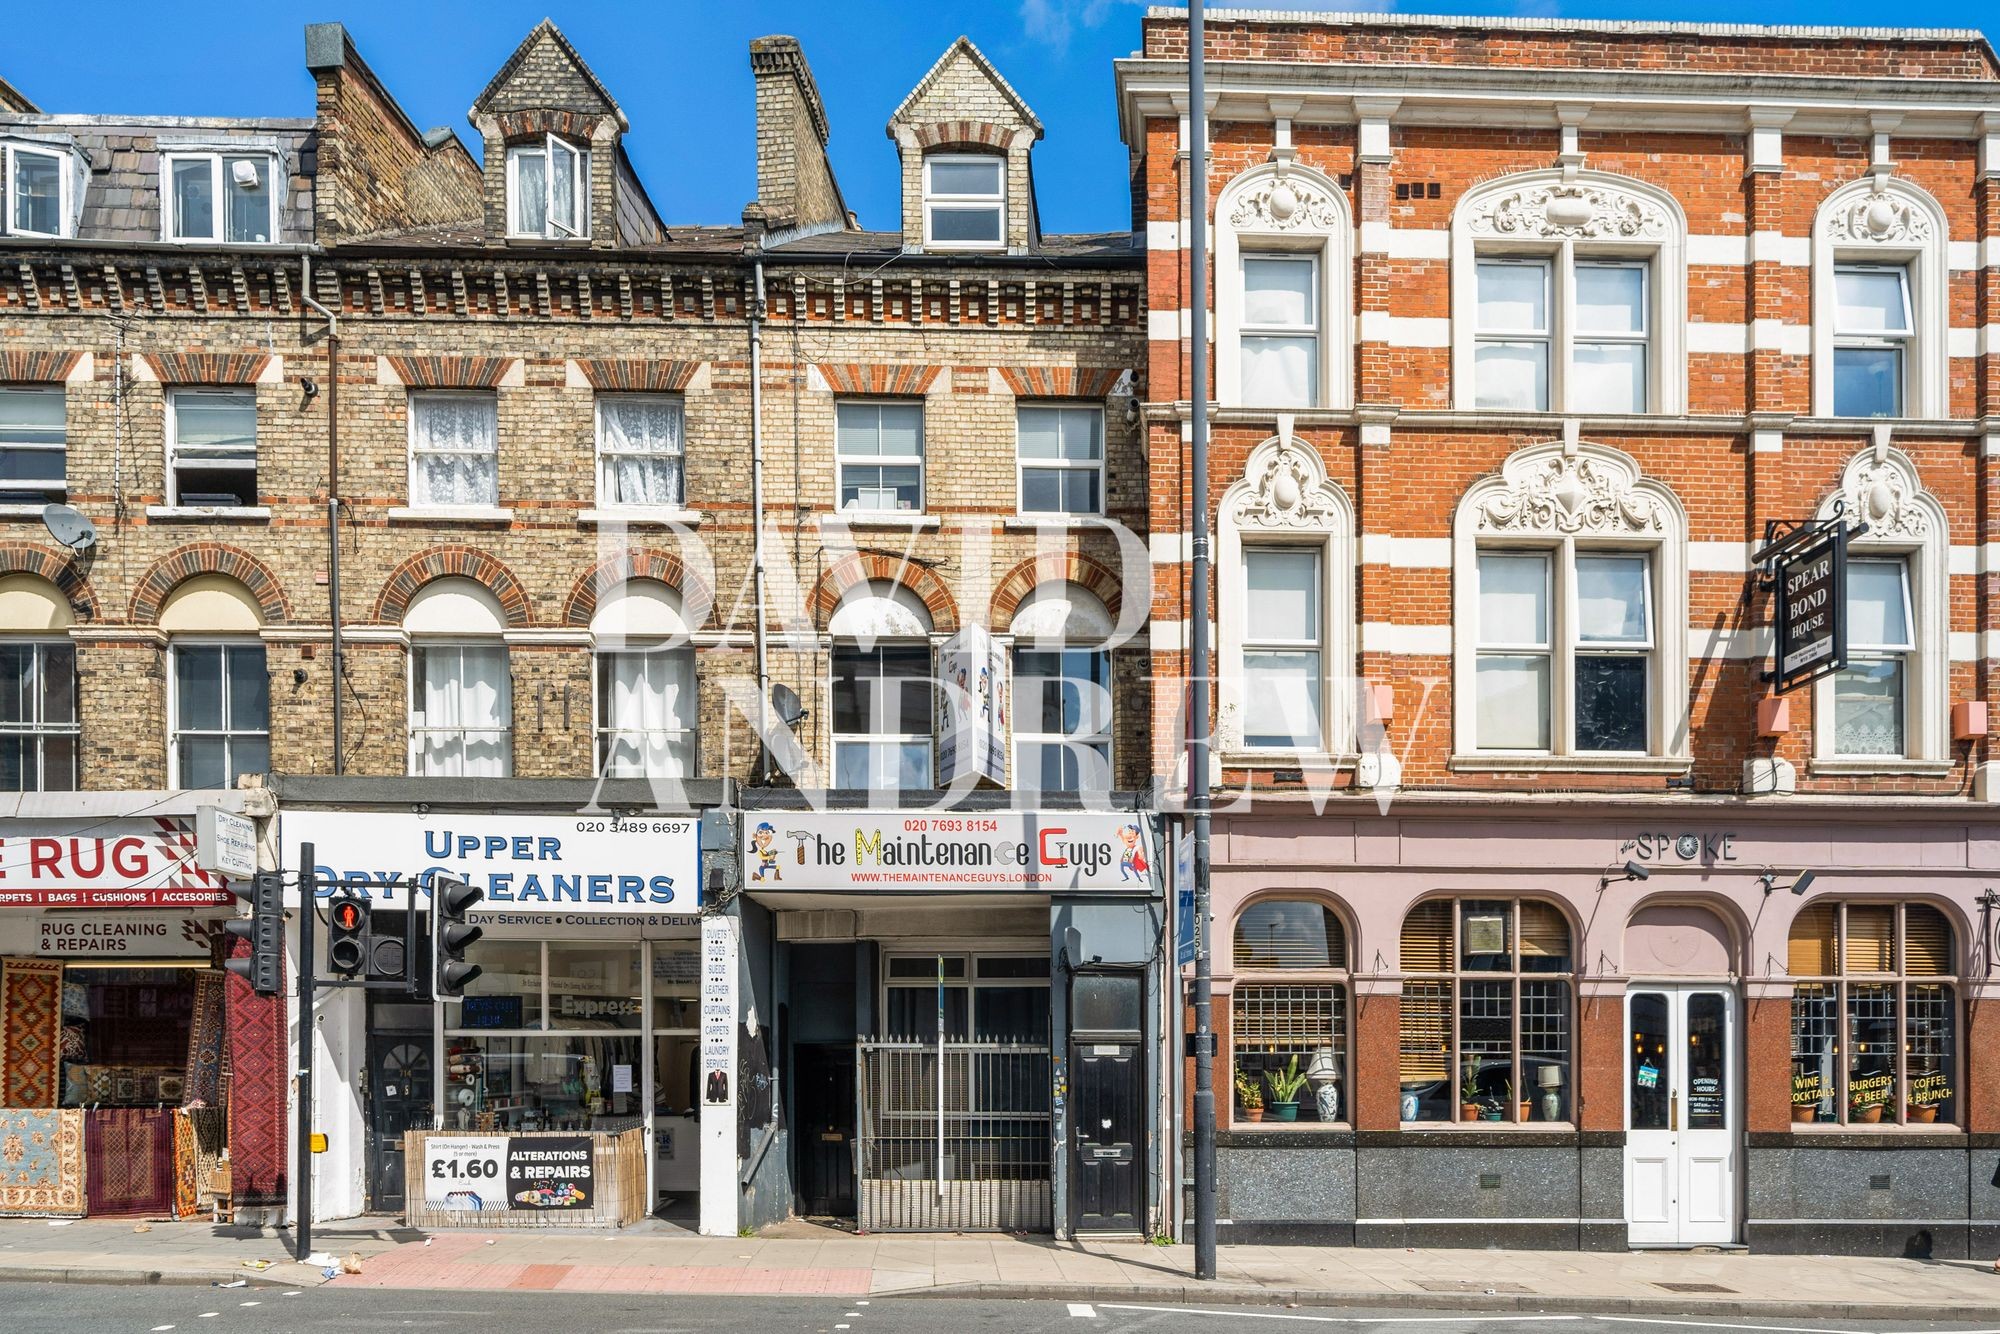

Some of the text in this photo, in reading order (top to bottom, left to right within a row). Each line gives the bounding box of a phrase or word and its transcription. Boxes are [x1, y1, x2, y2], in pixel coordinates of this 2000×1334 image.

[1787, 560, 1829, 596] SPEAR
[1790, 588, 1827, 620] BOND
[1792, 613, 1824, 639] HOUSE
[576, 822, 690, 834] 020 3489 6697
[904, 819, 998, 832] 020 7693 8154
[424, 831, 562, 861] UPPER
[855, 827, 1030, 866] Maintenance
[1039, 828, 1112, 877] Guys
[1637, 832, 1737, 860] SPOKE
[30, 838, 149, 879] RUG
[851, 873, 1052, 883] WWW.THEMAINTENANCEGUYS.LONDON
[48, 893, 77, 902] BAGS
[92, 893, 147, 902] CUSHIONS
[162, 893, 228, 901] ACCESORIES
[469, 914, 701, 926] DAY SERVICE COLLECTION & DELIV
[41, 923, 167, 935] RUG CLEANING
[706, 929, 728, 939] DUVETS
[41, 939, 127, 950] & REPAIRS
[708, 946, 726, 955] SHOES
[708, 964, 726, 974] SUEDE
[705, 985, 729, 994] LEATHER
[561, 995, 635, 1018] Express
[704, 1005, 730, 1015] CURTAINS
[705, 1026, 729, 1035] CARPETS
[705, 1046, 729, 1055] LAUNDRY
[706, 1059, 729, 1068] SERVICE
[1795, 1076, 1819, 1089] WINE
[1849, 1076, 1892, 1091] BURGERS
[1914, 1075, 1946, 1089] COFFEE
[1854, 1089, 1888, 1103] & BEER
[1907, 1088, 1952, 1103] & BRUNCH
[450, 1143, 468, 1151] Hanger)
[510, 1151, 587, 1161] ALTERATIONS
[432, 1159, 499, 1179] £1.60
[510, 1166, 591, 1178] & REPAIRS
